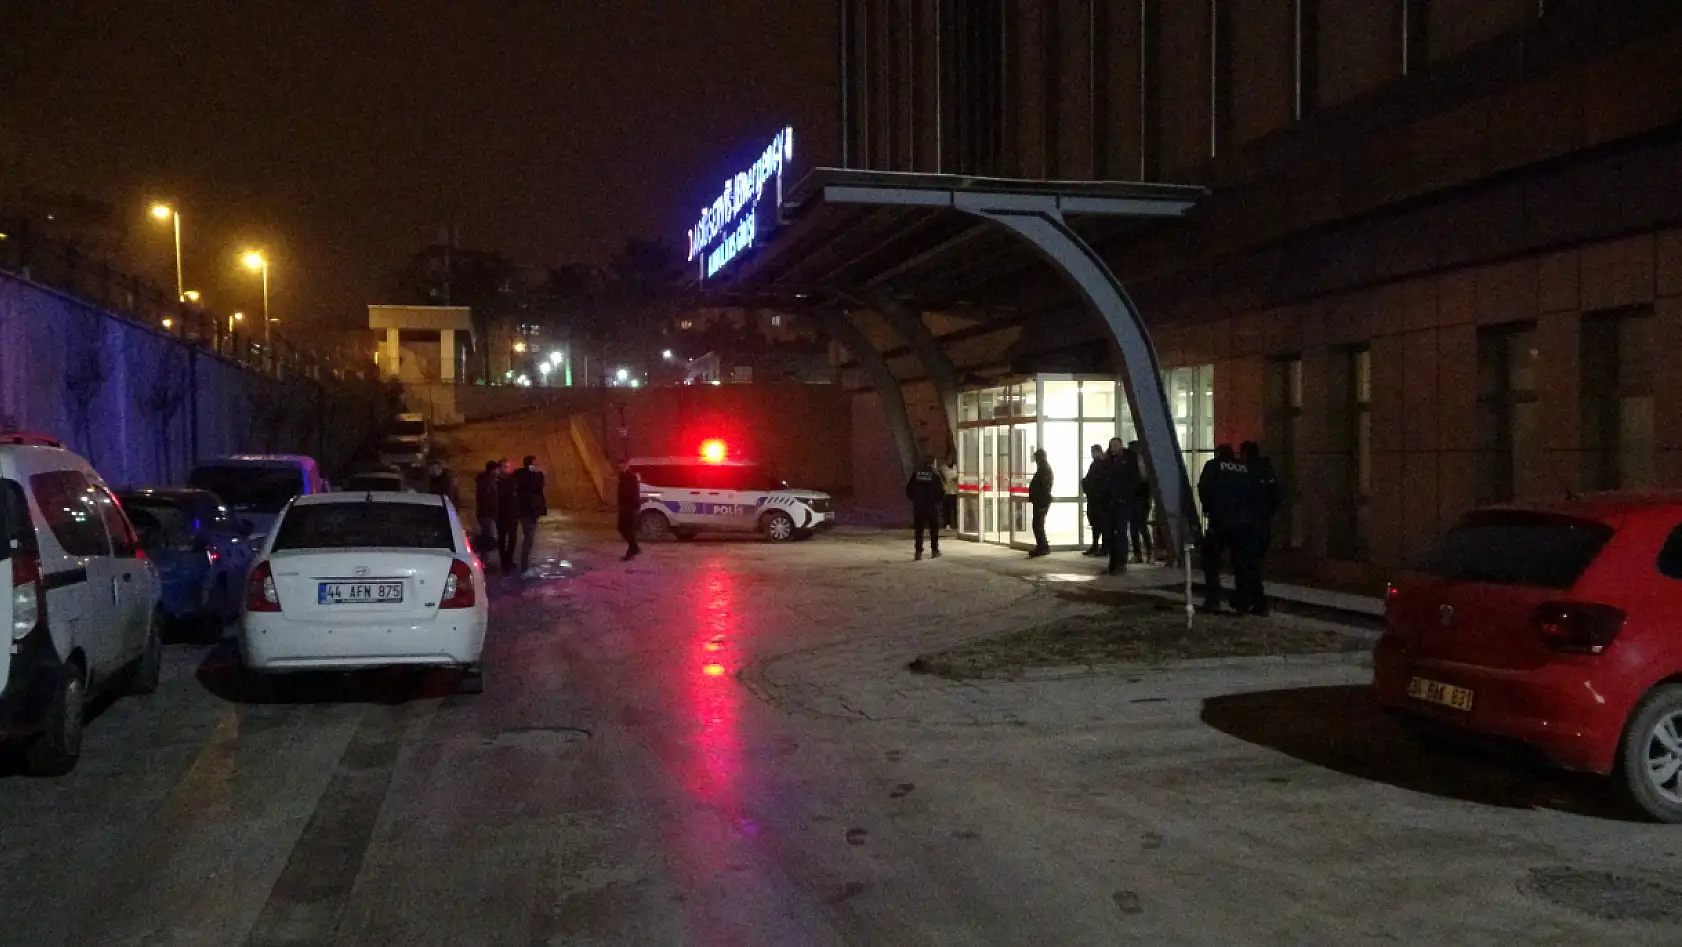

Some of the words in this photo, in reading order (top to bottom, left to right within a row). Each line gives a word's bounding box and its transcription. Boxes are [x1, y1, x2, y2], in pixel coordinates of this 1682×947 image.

[328, 585, 341, 598] 44
[350, 585, 371, 598] AFN
[378, 585, 400, 597] 875
